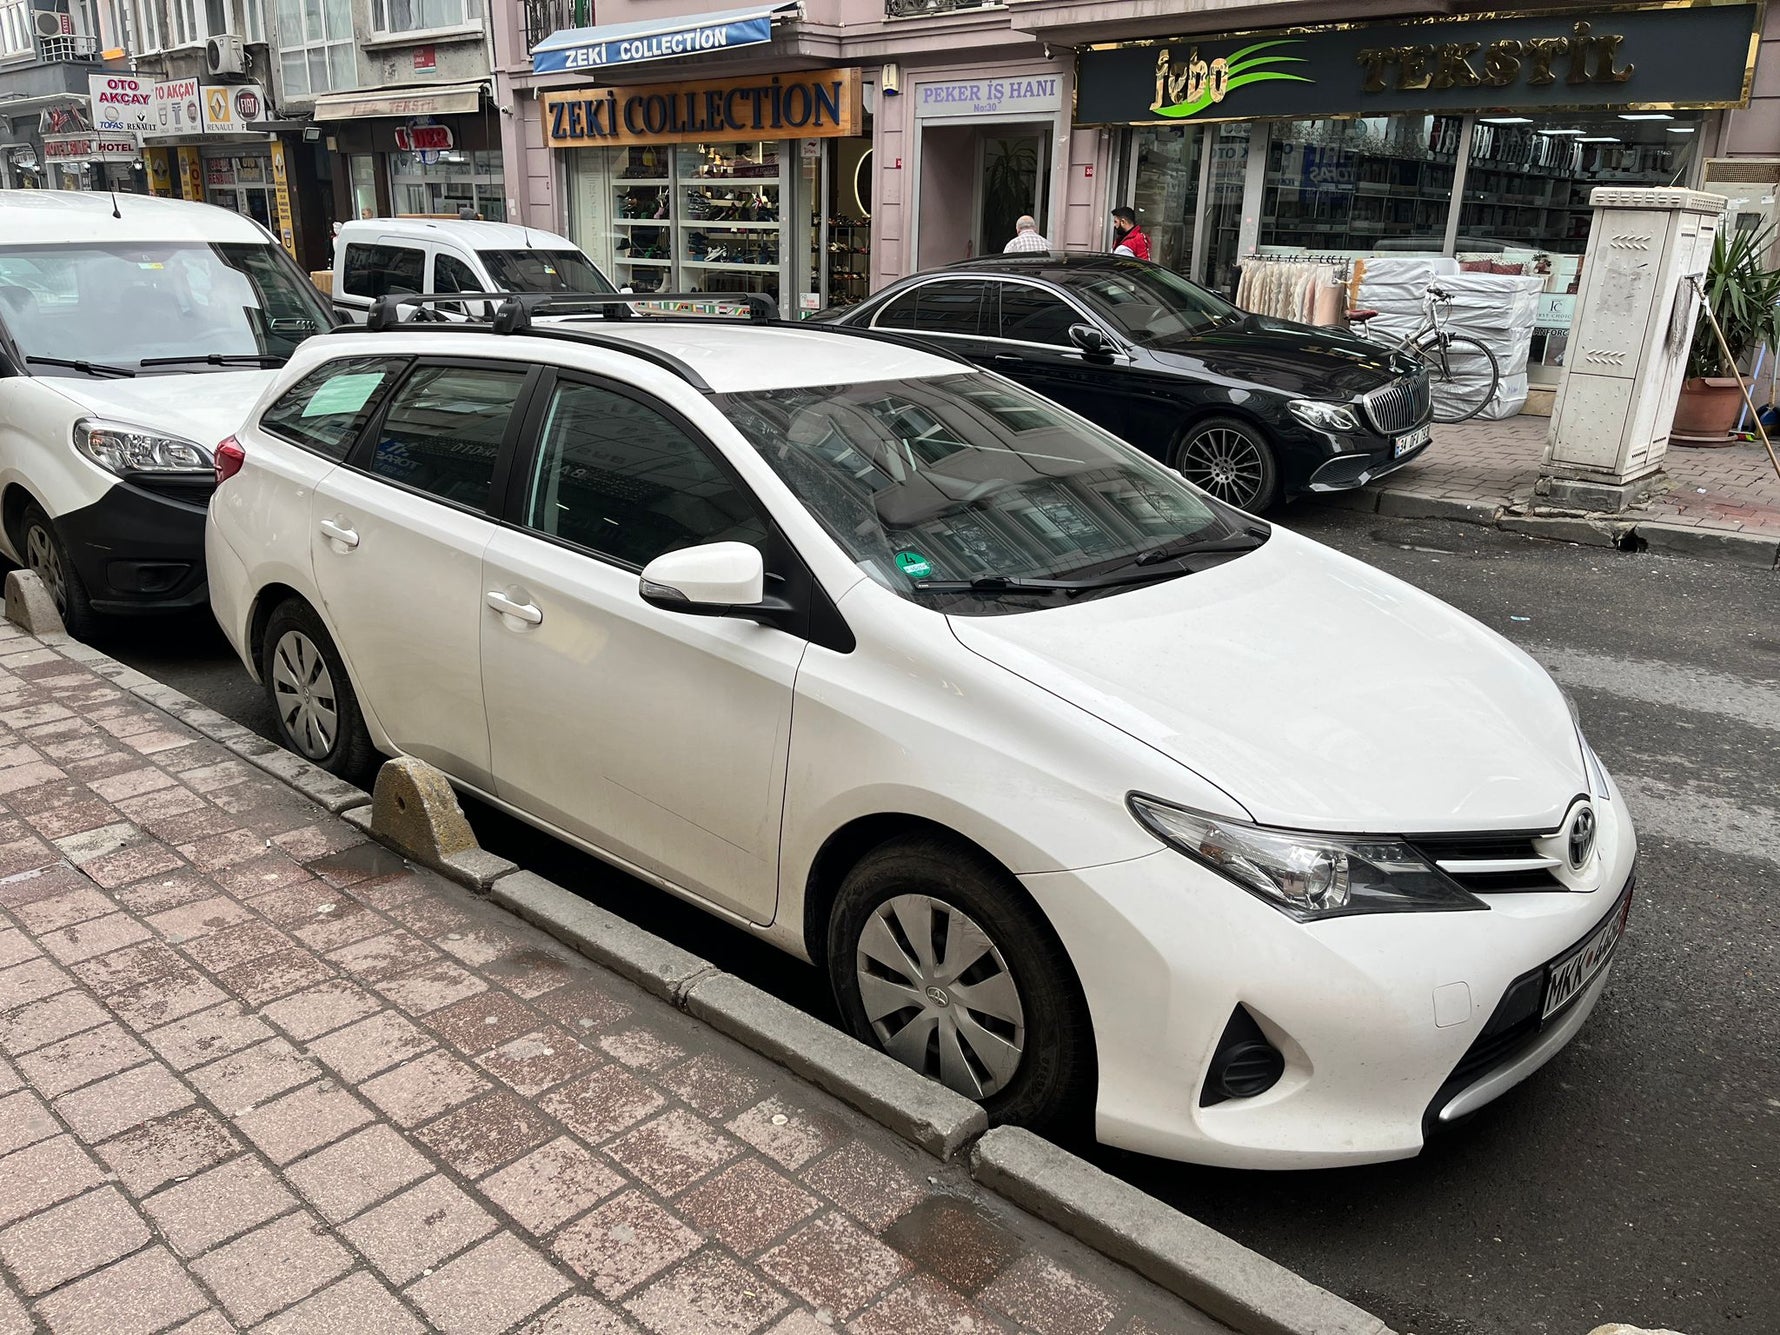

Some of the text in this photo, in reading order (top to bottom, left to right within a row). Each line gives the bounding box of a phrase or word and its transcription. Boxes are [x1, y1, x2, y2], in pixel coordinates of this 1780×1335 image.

[565, 27, 727, 68] ZEKİ COLLECTİON
[1357, 20, 1635, 92] TEKSTİL
[107, 79, 139, 91] OTO
[167, 82, 195, 101] AKÇAY
[923, 79, 1056, 104] PEKER İŞ HANI
[99, 92, 152, 106] AKÇAY
[240, 98, 255, 113] FIAT
[549, 76, 842, 139] ZEKİ COLLECTİON
[973, 102, 997, 113] No:30
[127, 122, 157, 131] RENAULT
[206, 123, 234, 132] RENAULT
[98, 143, 134, 152] HOTEL
[903, 553, 916, 564] 4
[1546, 947, 1590, 1012] MKK
